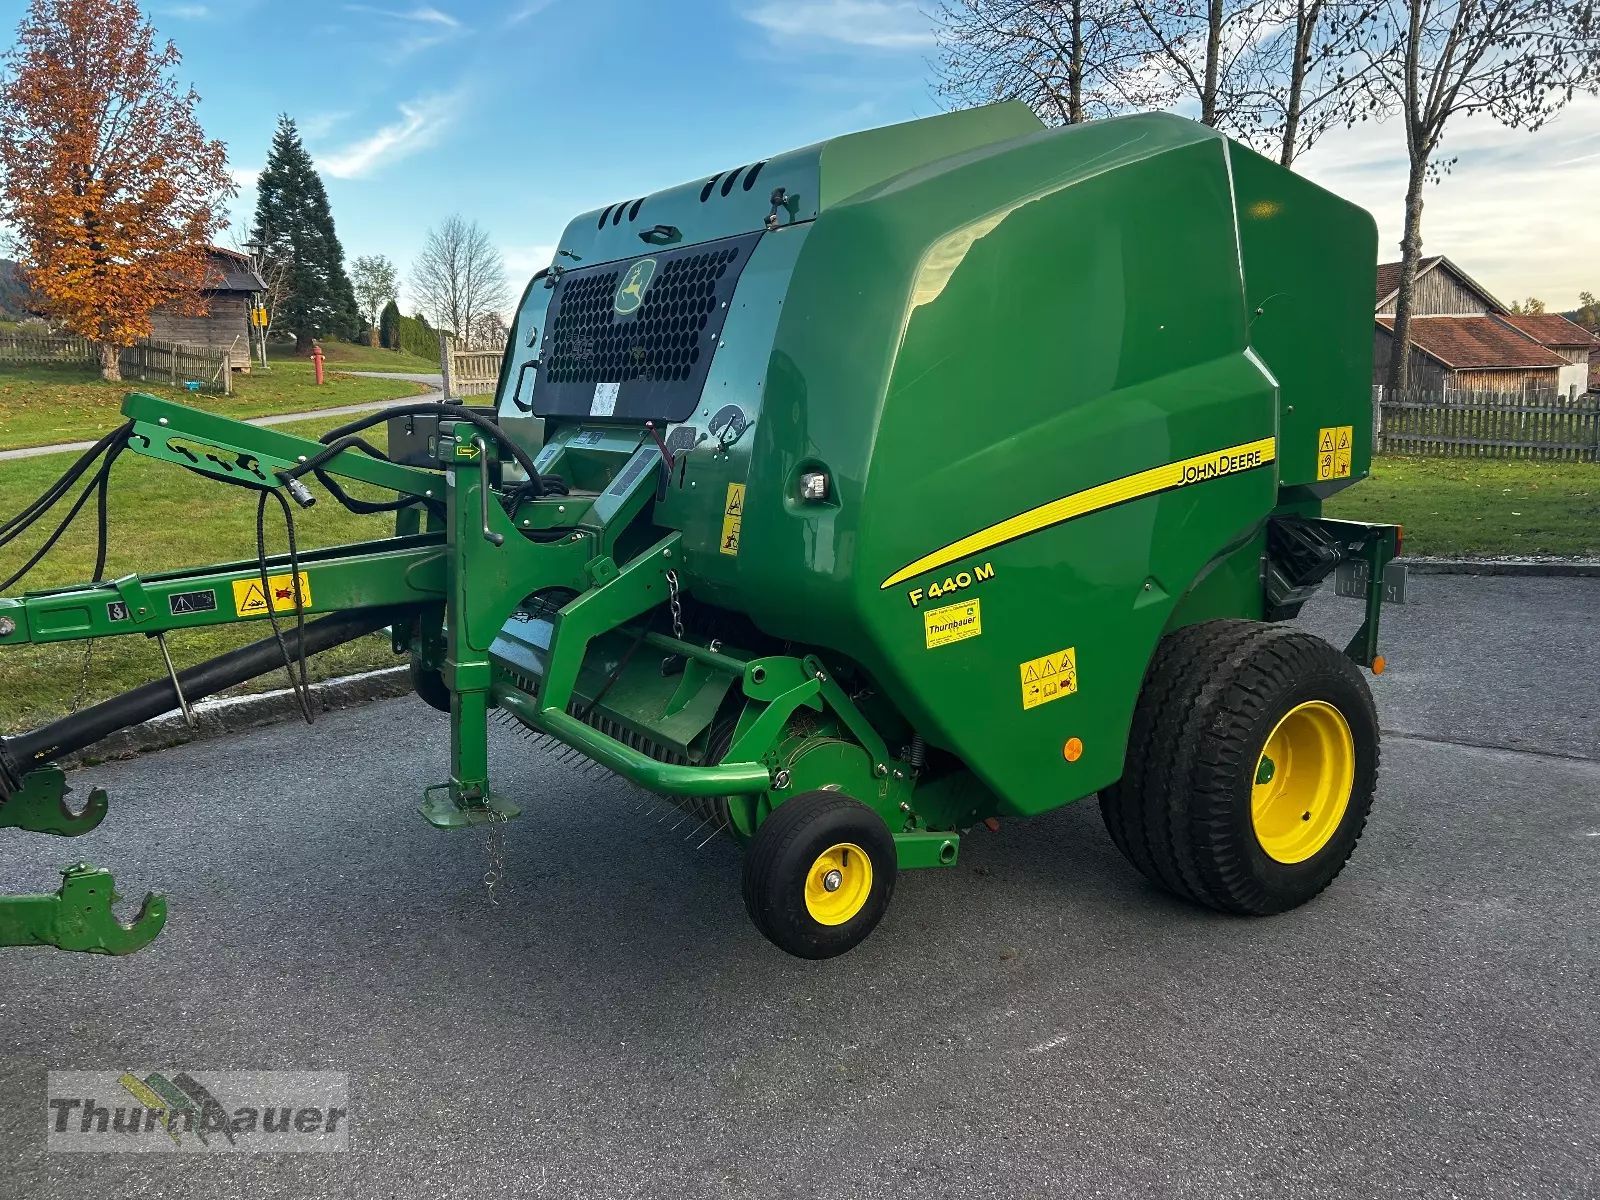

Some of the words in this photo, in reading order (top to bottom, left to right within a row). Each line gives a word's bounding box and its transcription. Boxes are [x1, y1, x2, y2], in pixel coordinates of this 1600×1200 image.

[1177, 461, 1217, 485] JOHN
[1219, 450, 1262, 473] DEERE
[908, 587, 923, 607] F
[928, 572, 972, 600] 440
[973, 562, 995, 583] M
[928, 615, 976, 635] Thurnbauer
